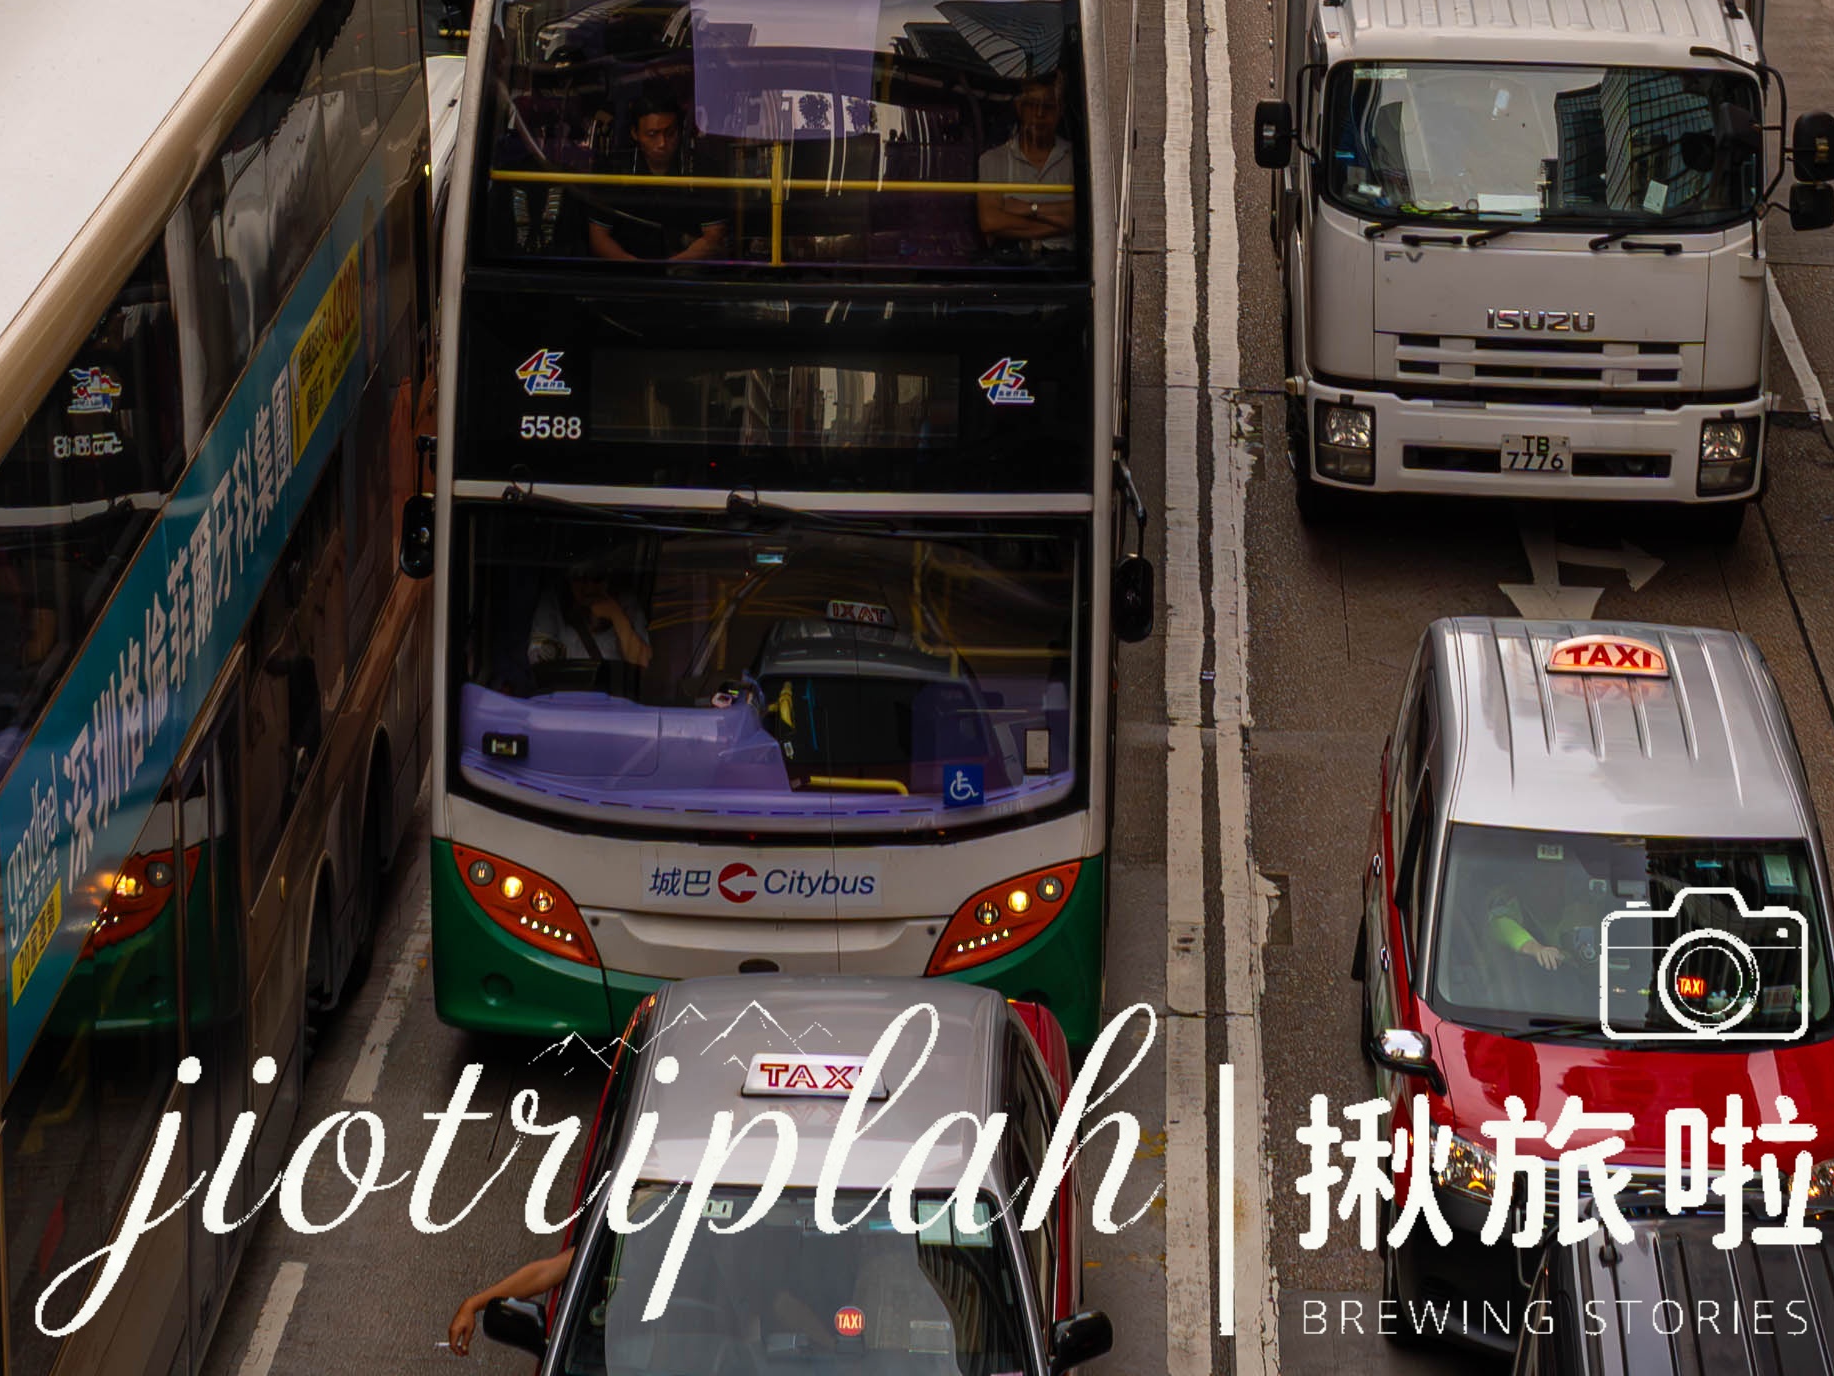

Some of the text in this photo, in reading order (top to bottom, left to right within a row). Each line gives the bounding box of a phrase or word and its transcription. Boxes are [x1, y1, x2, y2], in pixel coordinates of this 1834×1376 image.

[1486, 308, 1596, 334] ISUZU
[519, 415, 582, 441] 5588
[1521, 435, 1551, 457] TB
[1506, 451, 1566, 473] 7776
[1569, 644, 1653, 671] TAXI
[649, 868, 712, 899] 城巴
[763, 867, 876, 898] Citybus
[1678, 978, 1705, 996] TAXI
[836, 1314, 863, 1330] TAXI
